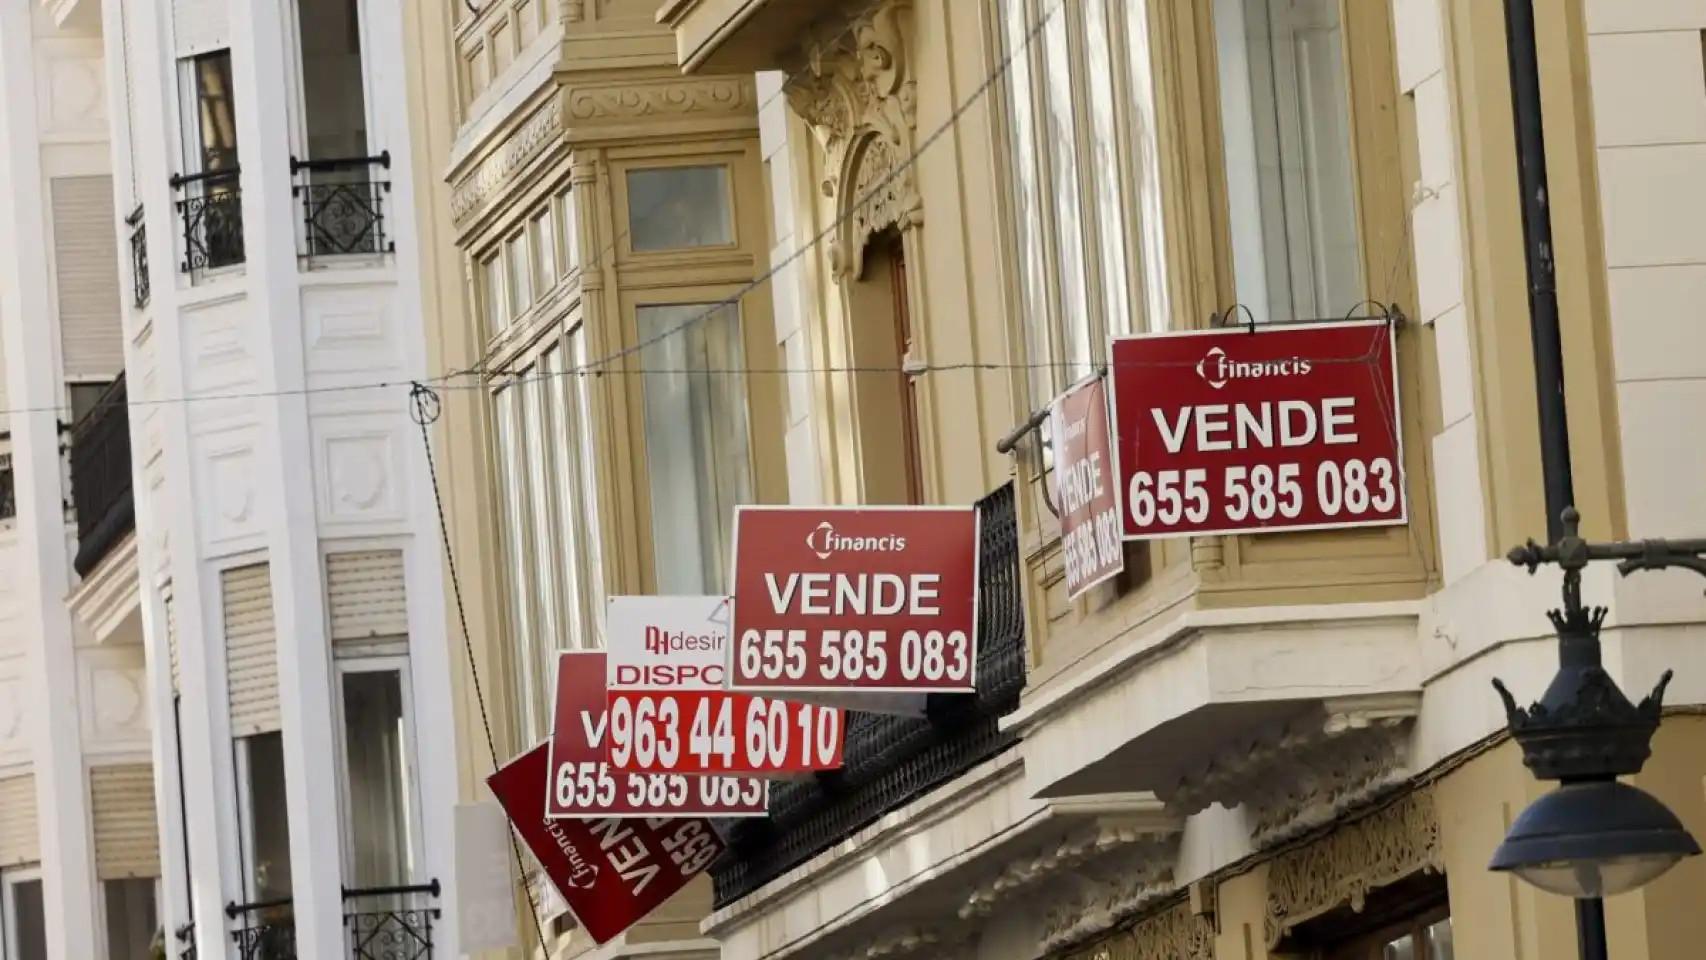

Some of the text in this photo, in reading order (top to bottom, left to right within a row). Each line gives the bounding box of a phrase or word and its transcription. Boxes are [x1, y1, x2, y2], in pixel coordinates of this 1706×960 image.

[1218, 355, 1312, 379] financis
[1150, 397, 1358, 454] VENDE
[1129, 457, 1396, 527] 655 585 083
[825, 530, 906, 552] financis
[764, 573, 941, 616] VENDE
[740, 628, 968, 681] 655 585 083
[610, 696, 680, 768] 963
[689, 697, 736, 768] 44
[745, 697, 789, 769] 60
[797, 703, 839, 767] 10
[556, 761, 616, 807] 655
[626, 772, 688, 807] 585
[582, 817, 661, 897] VEN
[660, 820, 718, 876] 655
